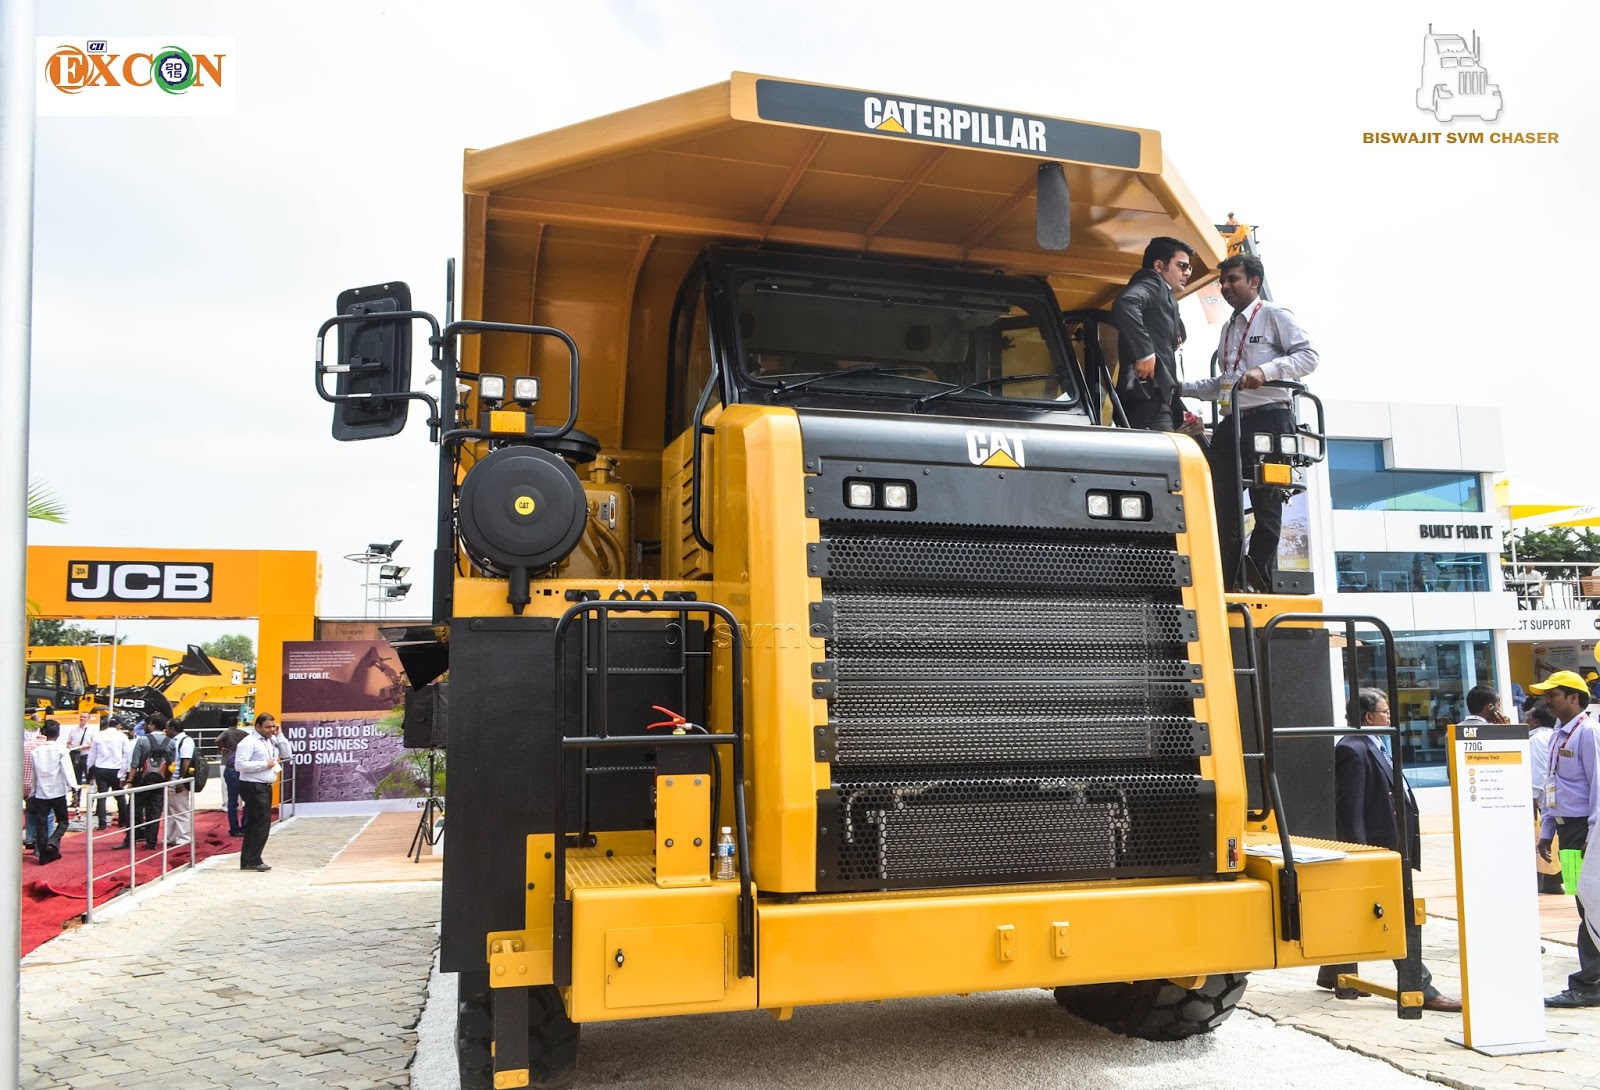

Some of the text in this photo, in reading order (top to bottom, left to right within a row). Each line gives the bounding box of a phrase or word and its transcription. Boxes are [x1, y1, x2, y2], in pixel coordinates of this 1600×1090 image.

[863, 96, 1047, 152] CATERPILLAR
[1249, 335, 1261, 344] CAT
[965, 429, 1027, 468] CAT
[518, 501, 530, 509] CAT
[1419, 524, 1454, 539] BUILT
[1456, 525, 1479, 539] FOR
[70, 564, 210, 599] JCB
[1530, 619, 1571, 630] SUPPORT
[288, 672, 308, 680] BUILT
[308, 672, 321, 680] FOR
[114, 699, 145, 709] JCB
[288, 727, 306, 739] NO
[309, 727, 333, 739] JOB
[337, 726, 359, 737] TOO
[1463, 727, 1479, 738] CAT
[290, 739, 369, 752] NO BUSINESS
[1464, 742, 1483, 751] 770G
[315, 752, 359, 765] SMALL.
